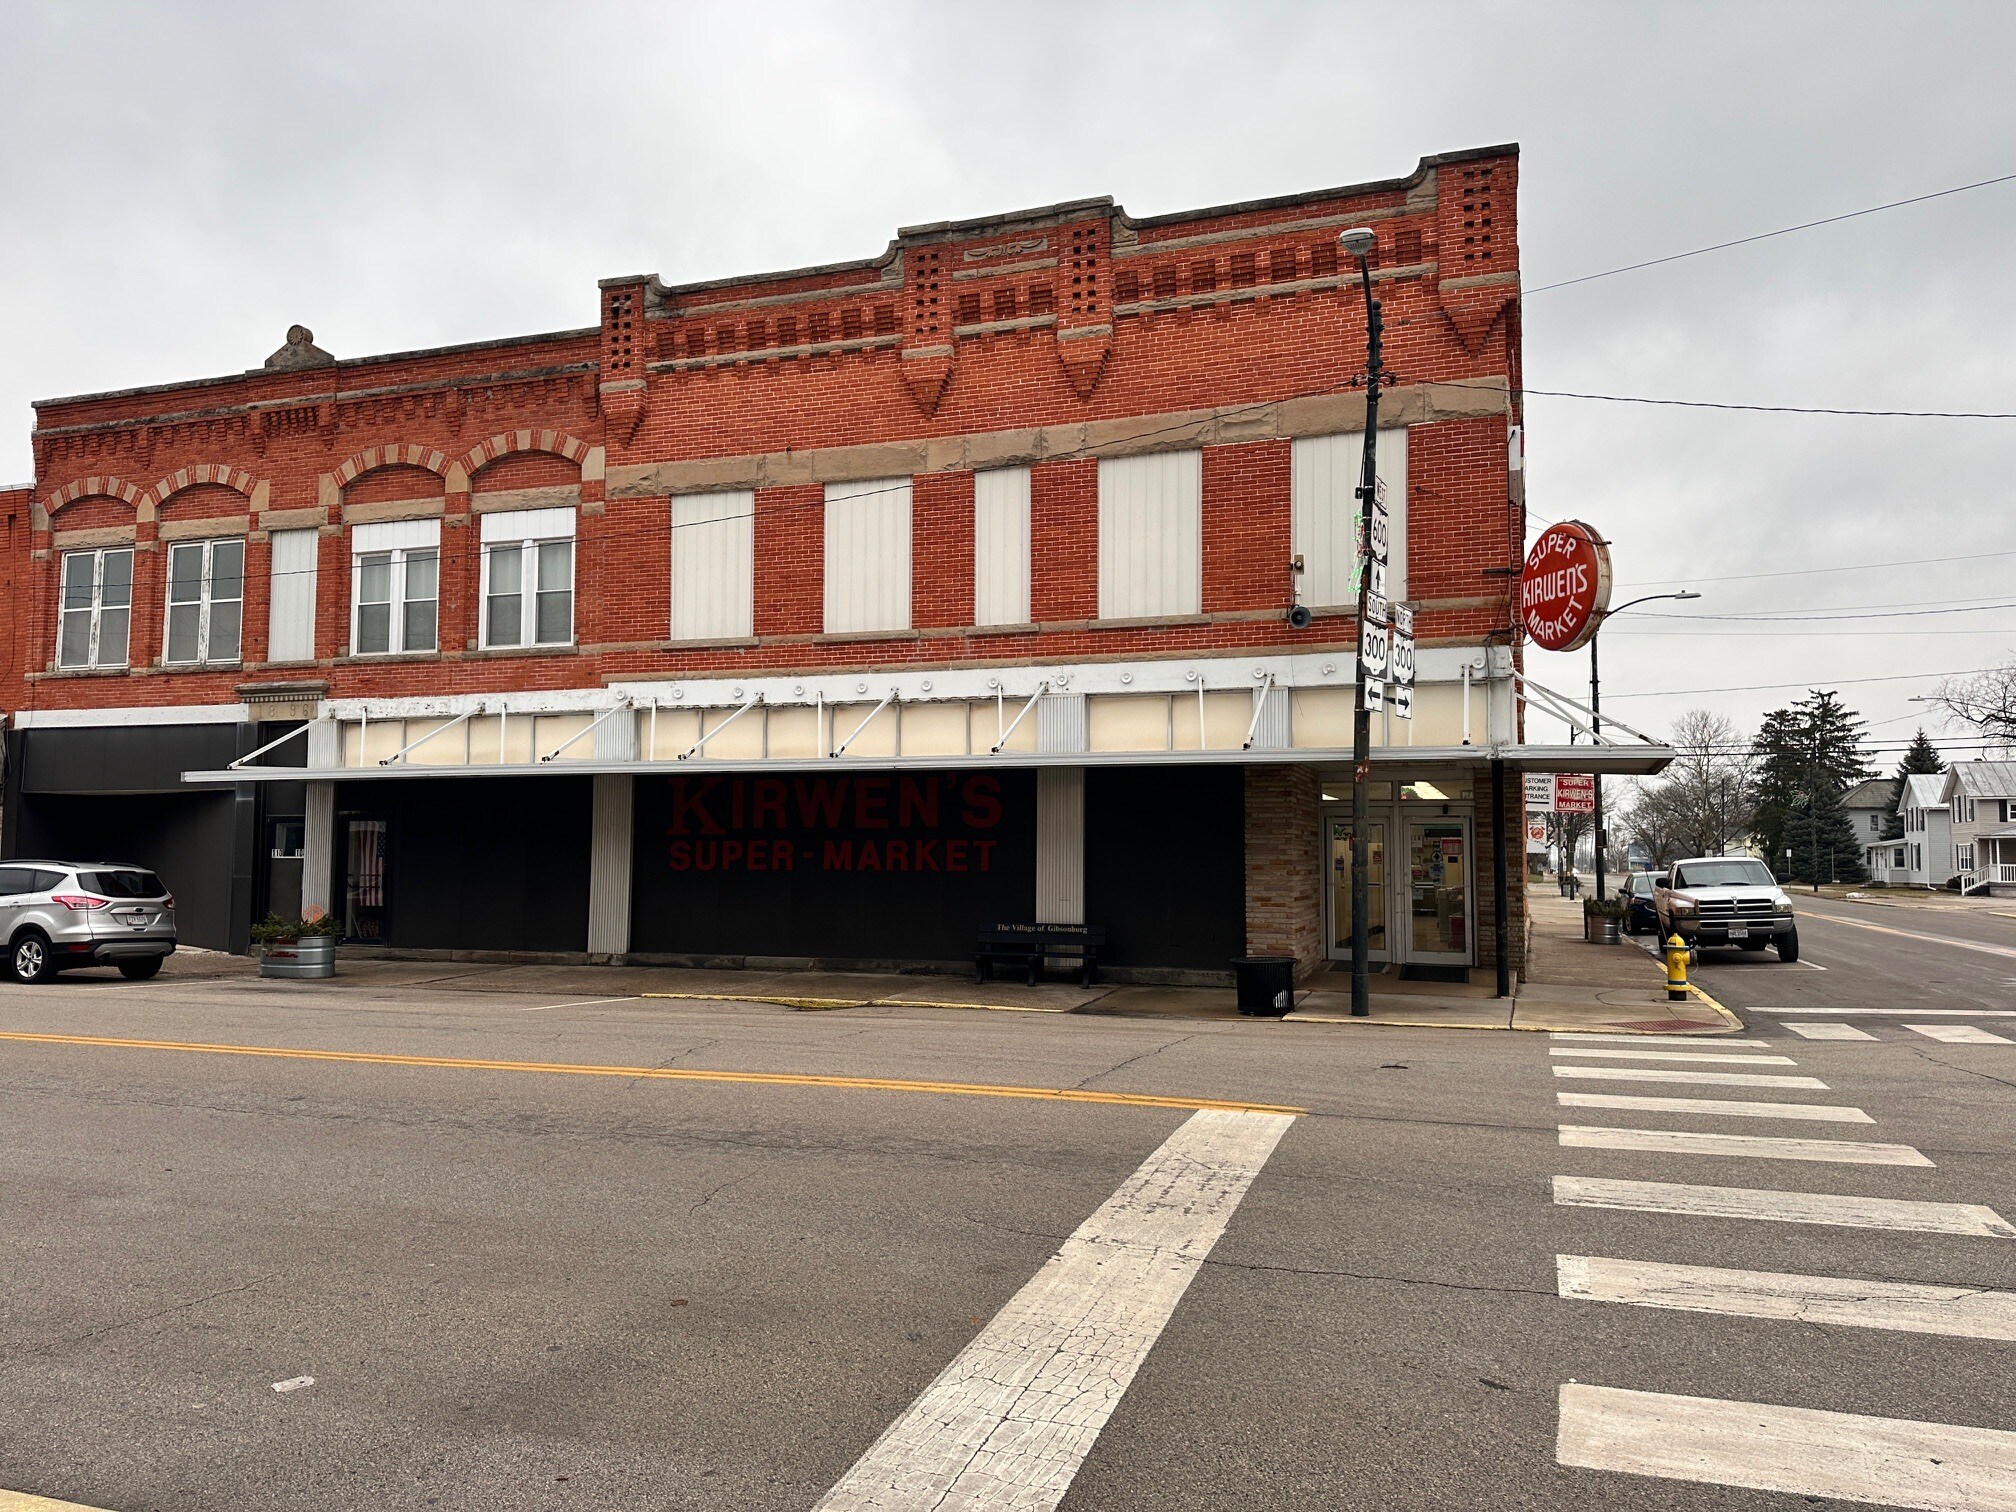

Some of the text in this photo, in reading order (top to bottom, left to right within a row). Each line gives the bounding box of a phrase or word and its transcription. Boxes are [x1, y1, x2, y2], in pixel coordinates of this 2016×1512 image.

[1373, 518, 1387, 548] 600
[1529, 532, 1577, 571] SUPER
[1522, 562, 1588, 609] KIRWEN'S
[1368, 595, 1387, 618] SOUTH
[1527, 595, 1583, 641] MARKET
[1364, 632, 1385, 662] 300
[1394, 643, 1413, 671] 300
[1563, 778, 1589, 786] SUPER
[666, 772, 1002, 835] KIRWEN'S
[1012, 925, 1036, 933] Village
[1047, 925, 1088, 934] Gibsonburg
